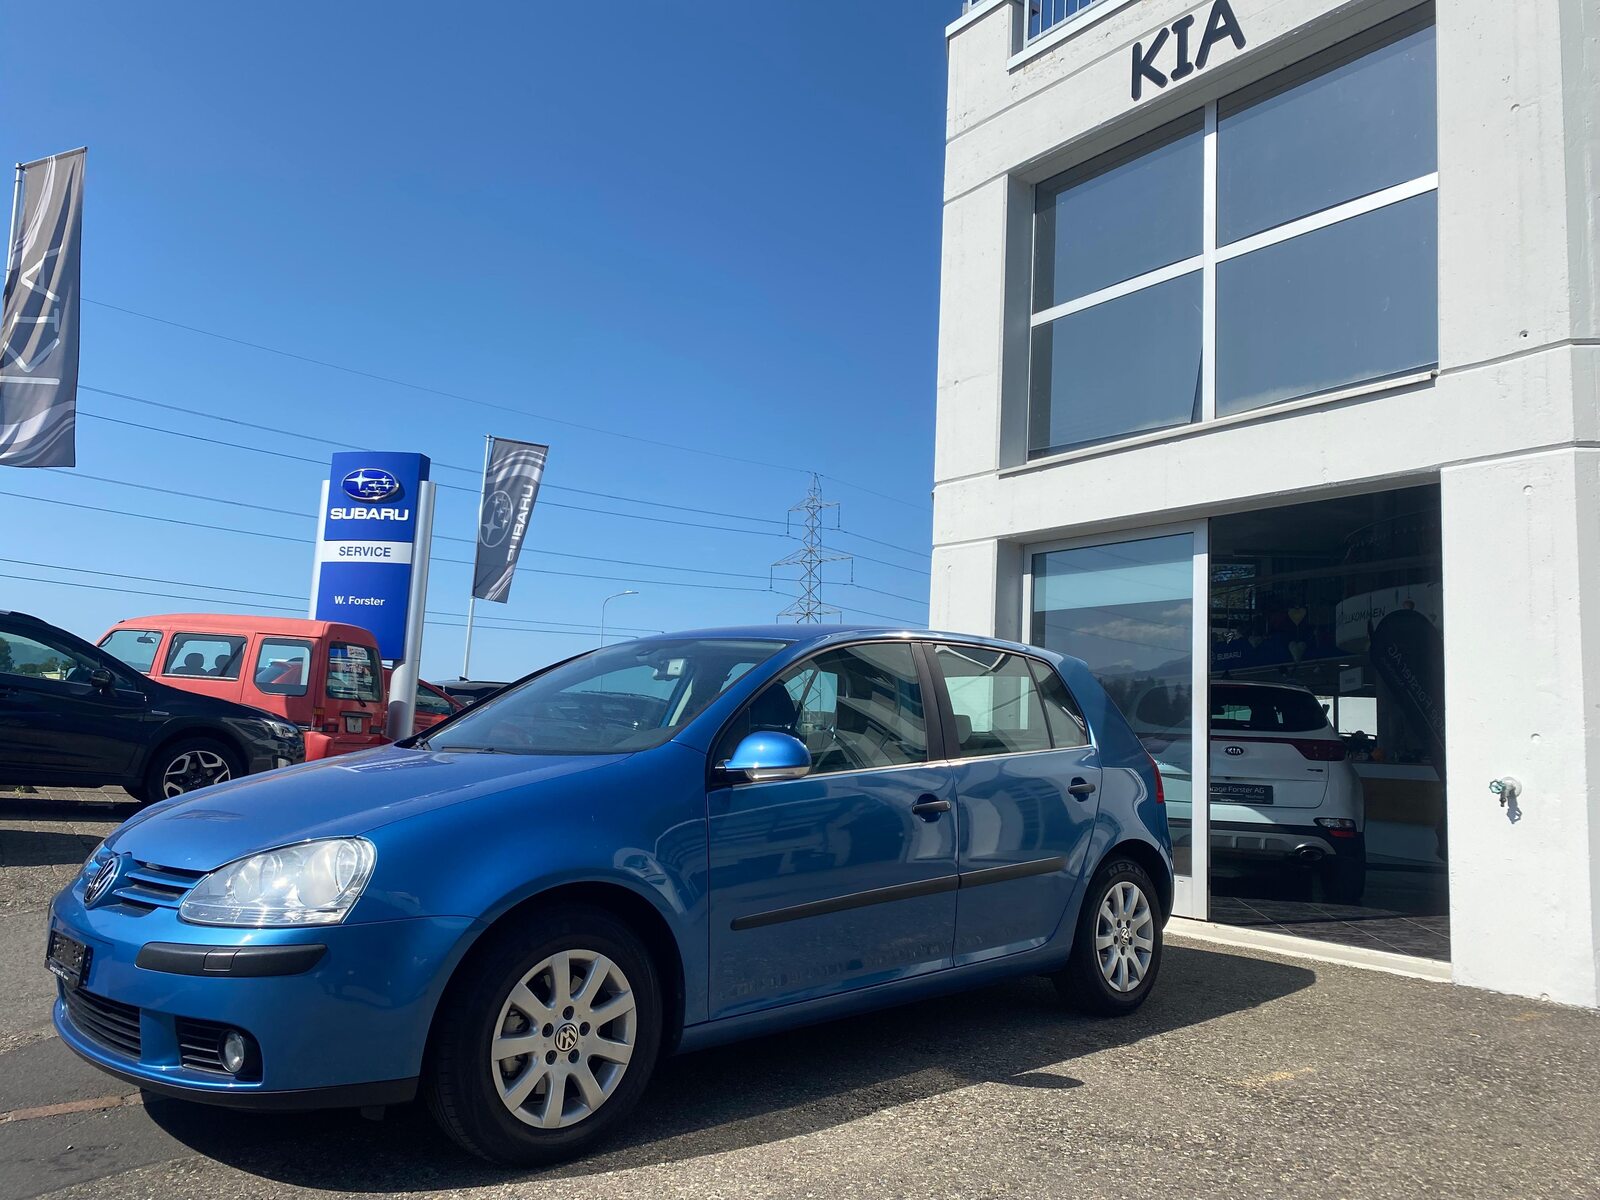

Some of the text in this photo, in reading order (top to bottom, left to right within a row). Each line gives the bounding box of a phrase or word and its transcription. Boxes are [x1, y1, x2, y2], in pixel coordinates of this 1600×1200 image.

[1131, 0, 1247, 101] KIA
[0, 244, 62, 385] KIA
[330, 507, 409, 521] SUBARU
[338, 546, 392, 557] SERVICE
[334, 595, 385, 606] W. Forster
[1228, 785, 1252, 793] Forster
[1254, 786, 1264, 794] AG
